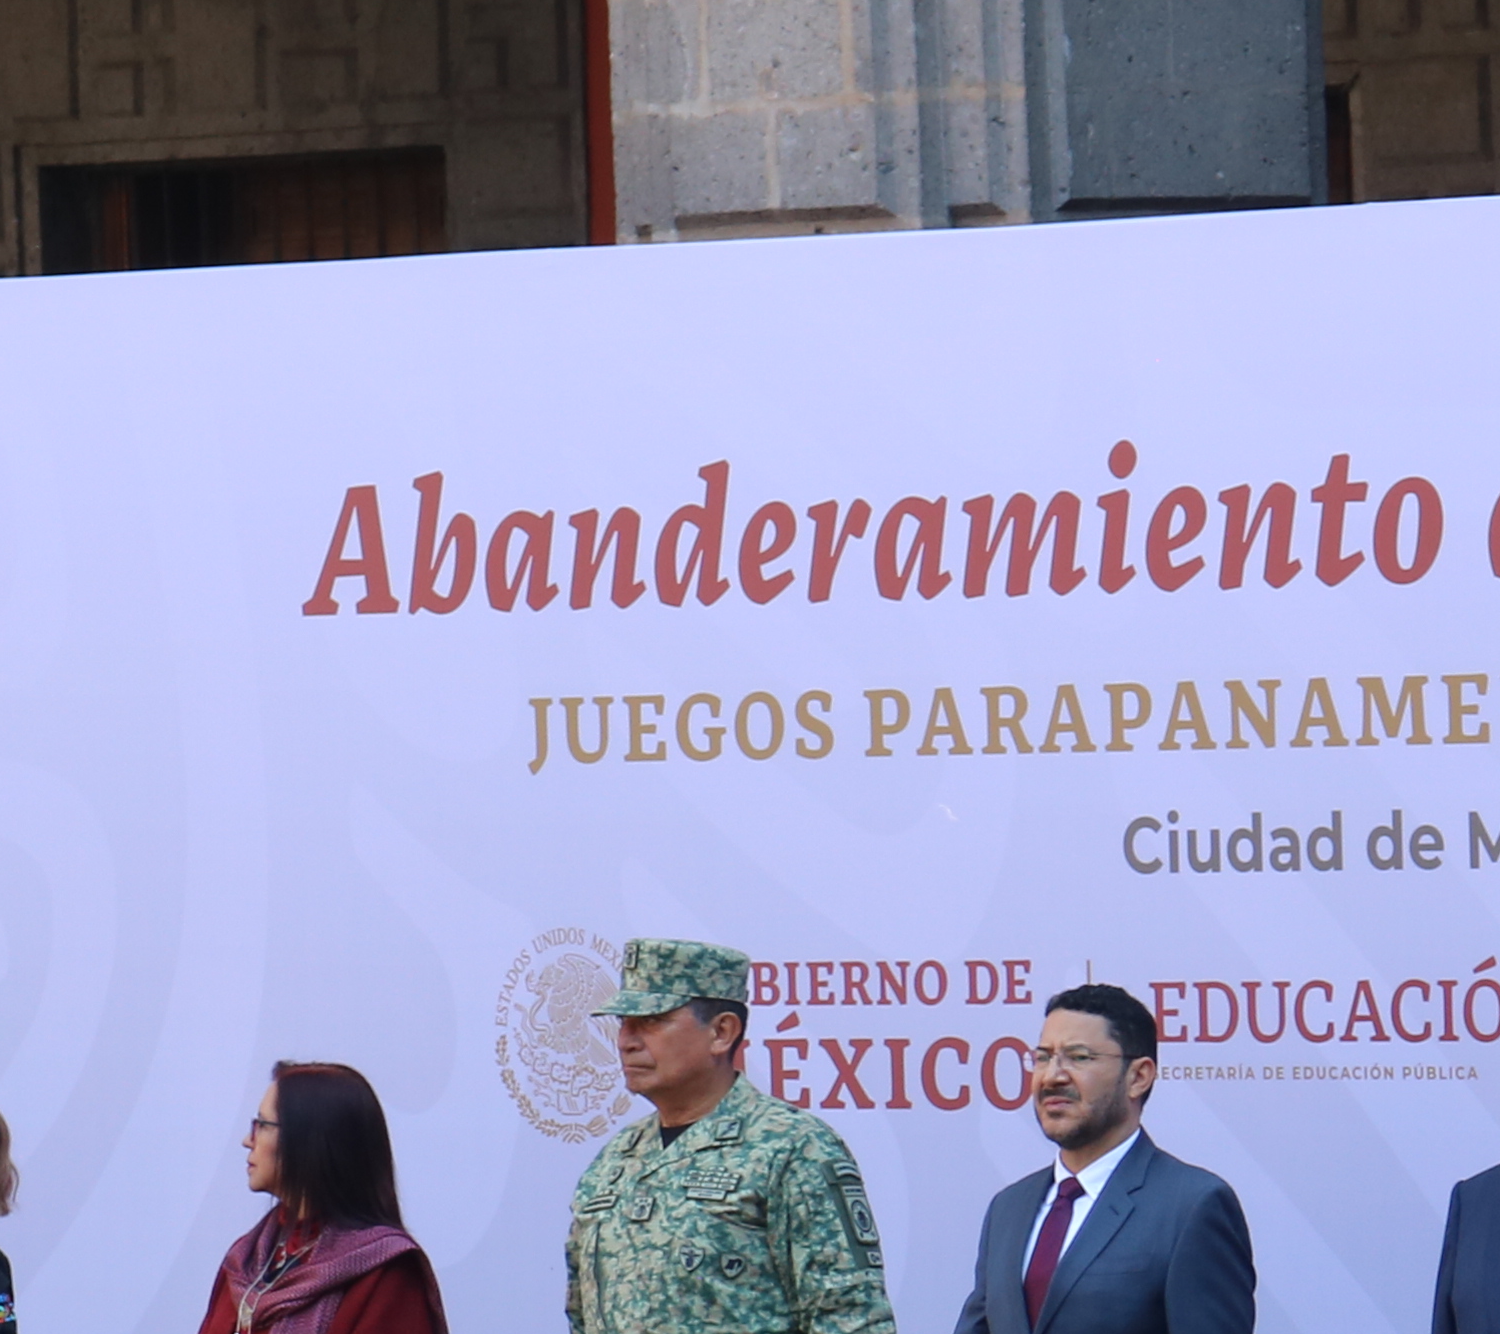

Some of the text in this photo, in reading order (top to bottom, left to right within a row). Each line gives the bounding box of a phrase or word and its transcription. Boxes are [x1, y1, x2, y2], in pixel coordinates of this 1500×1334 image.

[301, 439, 1445, 617] Abanderamiento
[527, 690, 836, 776] JUEGOS
[1122, 809, 1344, 875] Ciudad
[1366, 808, 1445, 872] de
[495, 927, 586, 1027] ESTADOS UNIDOS
[750, 959, 1033, 1006] BIERNO DE
[732, 1010, 1034, 1111] ÉXICO
[1155, 1062, 1479, 1081] ECRETARÍA DE EDUCACIÓN PÚBLICA
